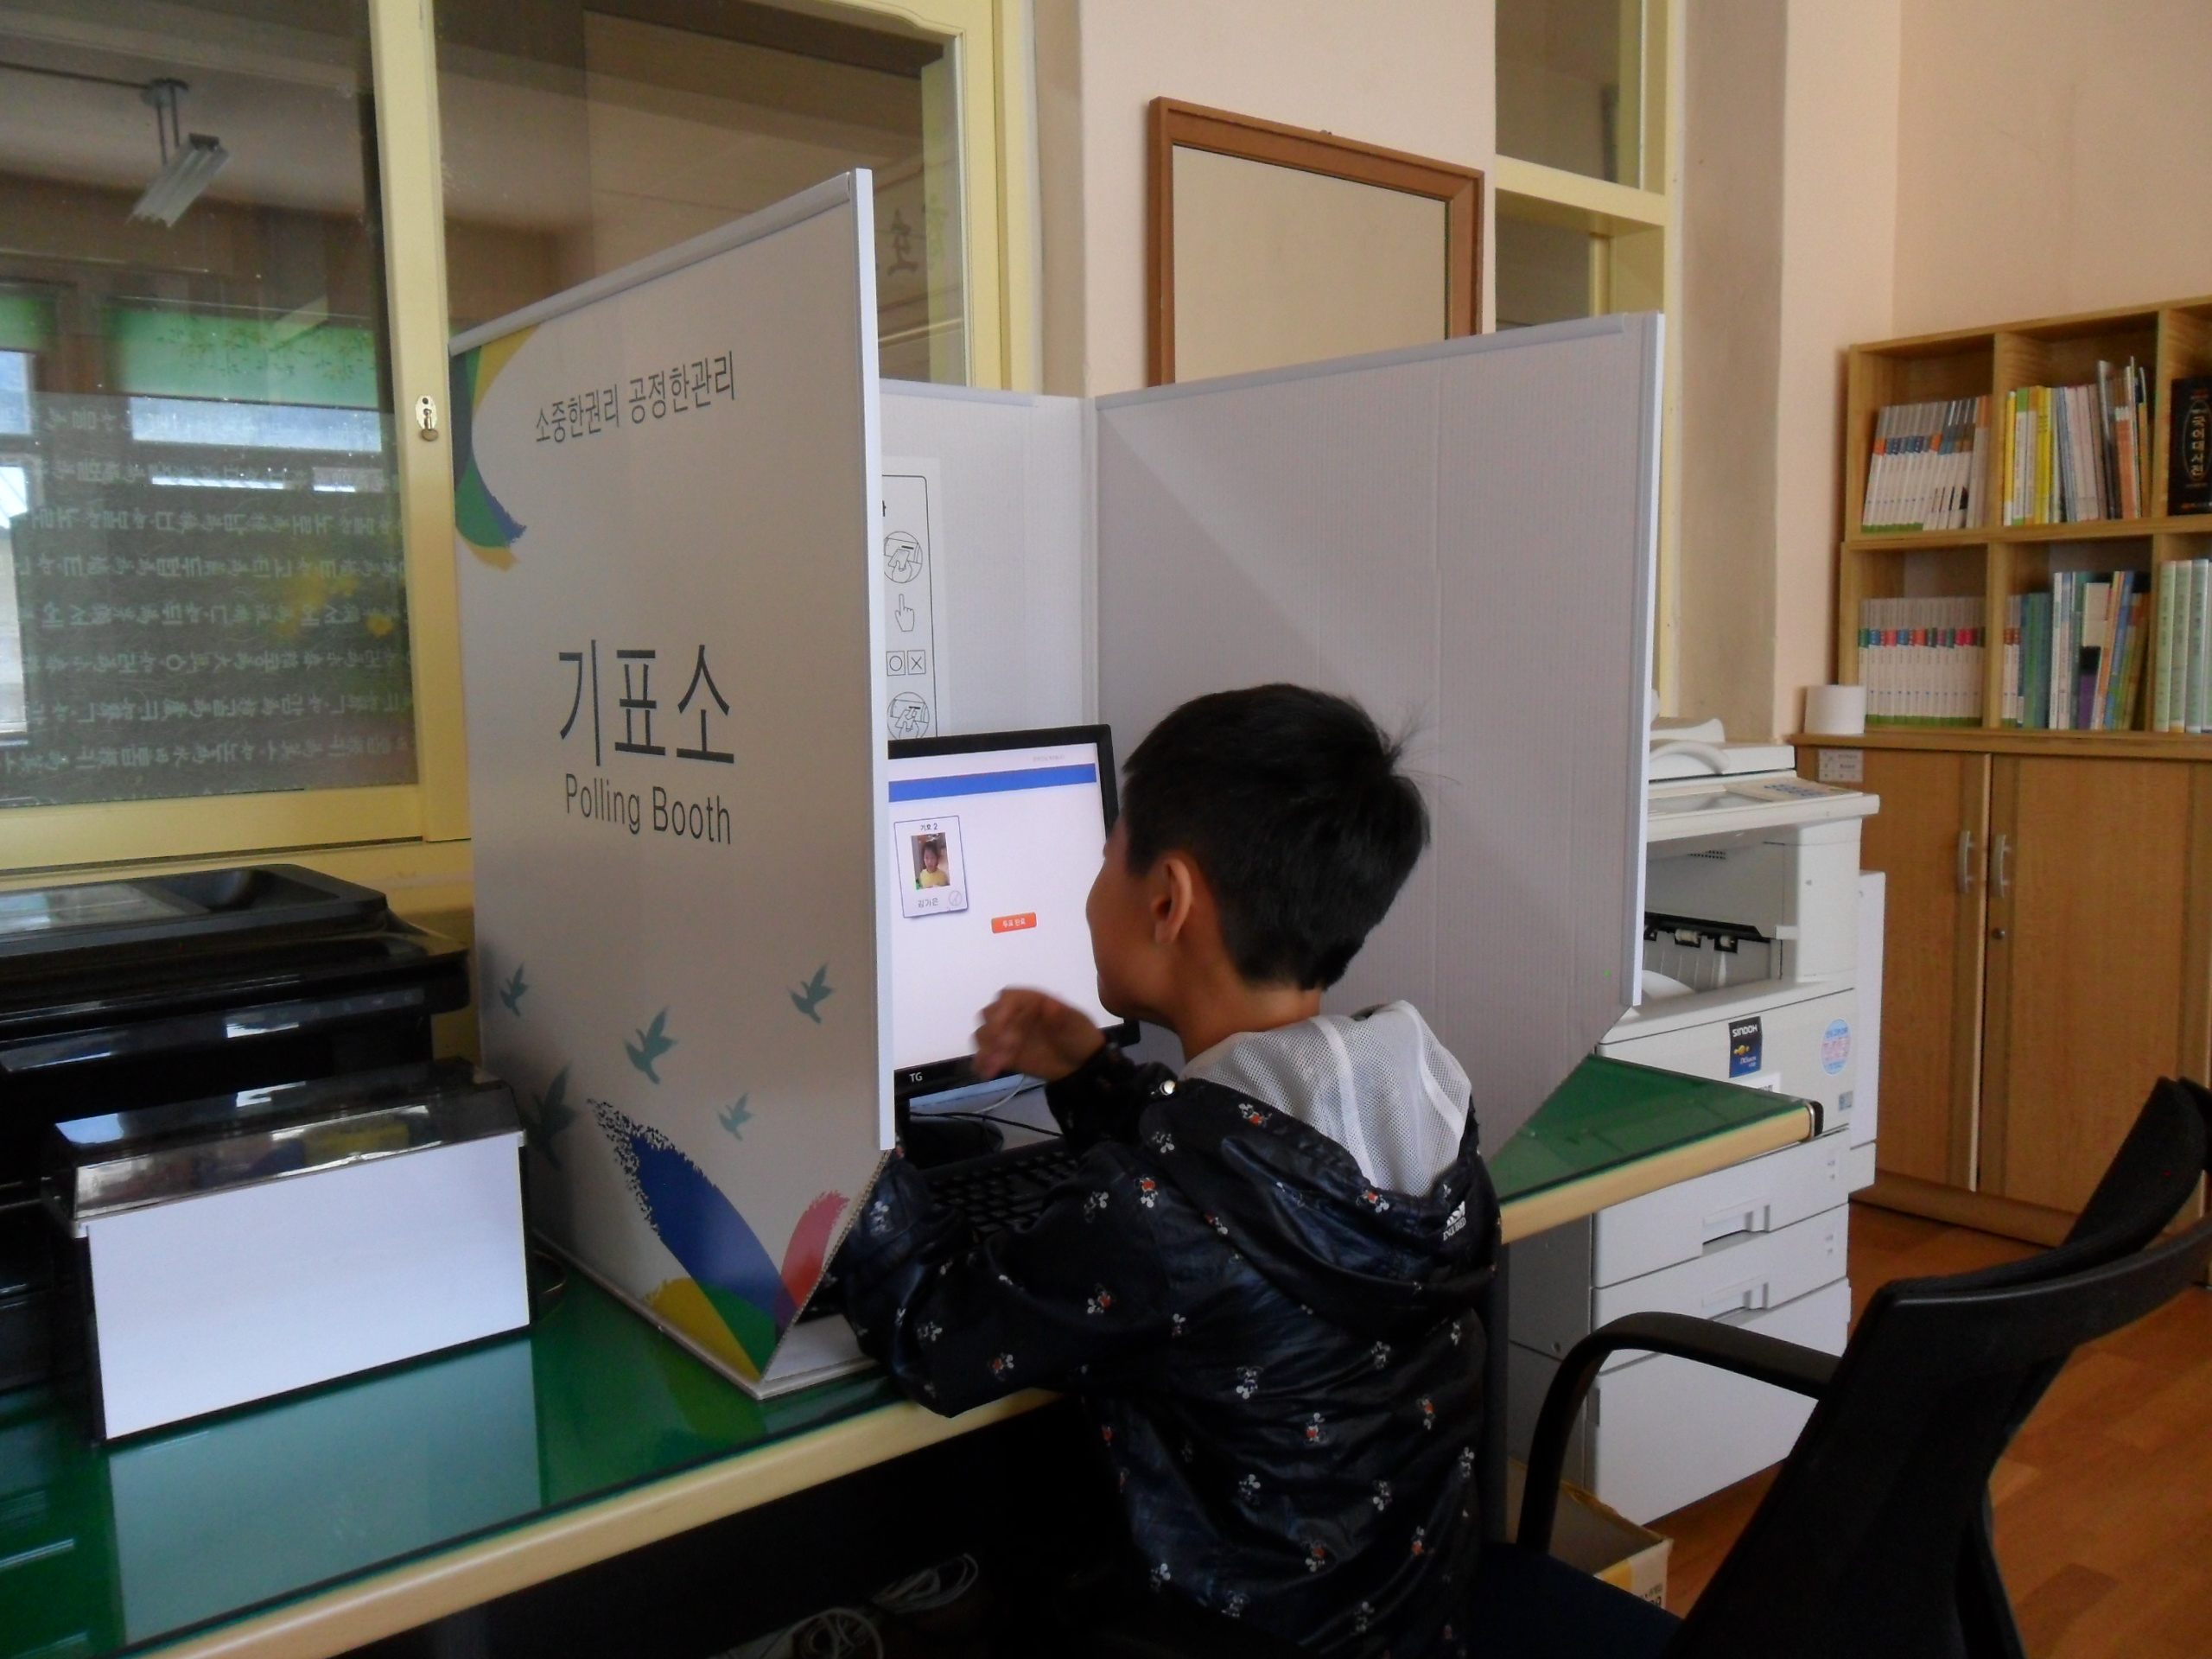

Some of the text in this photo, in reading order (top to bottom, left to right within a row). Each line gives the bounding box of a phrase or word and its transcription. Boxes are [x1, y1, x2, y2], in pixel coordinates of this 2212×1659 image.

[536, 350, 735, 443] 소중한권리 공정한관리
[559, 639, 734, 766] 기표소
[565, 772, 732, 845] Polling Booth
[909, 1071, 923, 1083] TG
